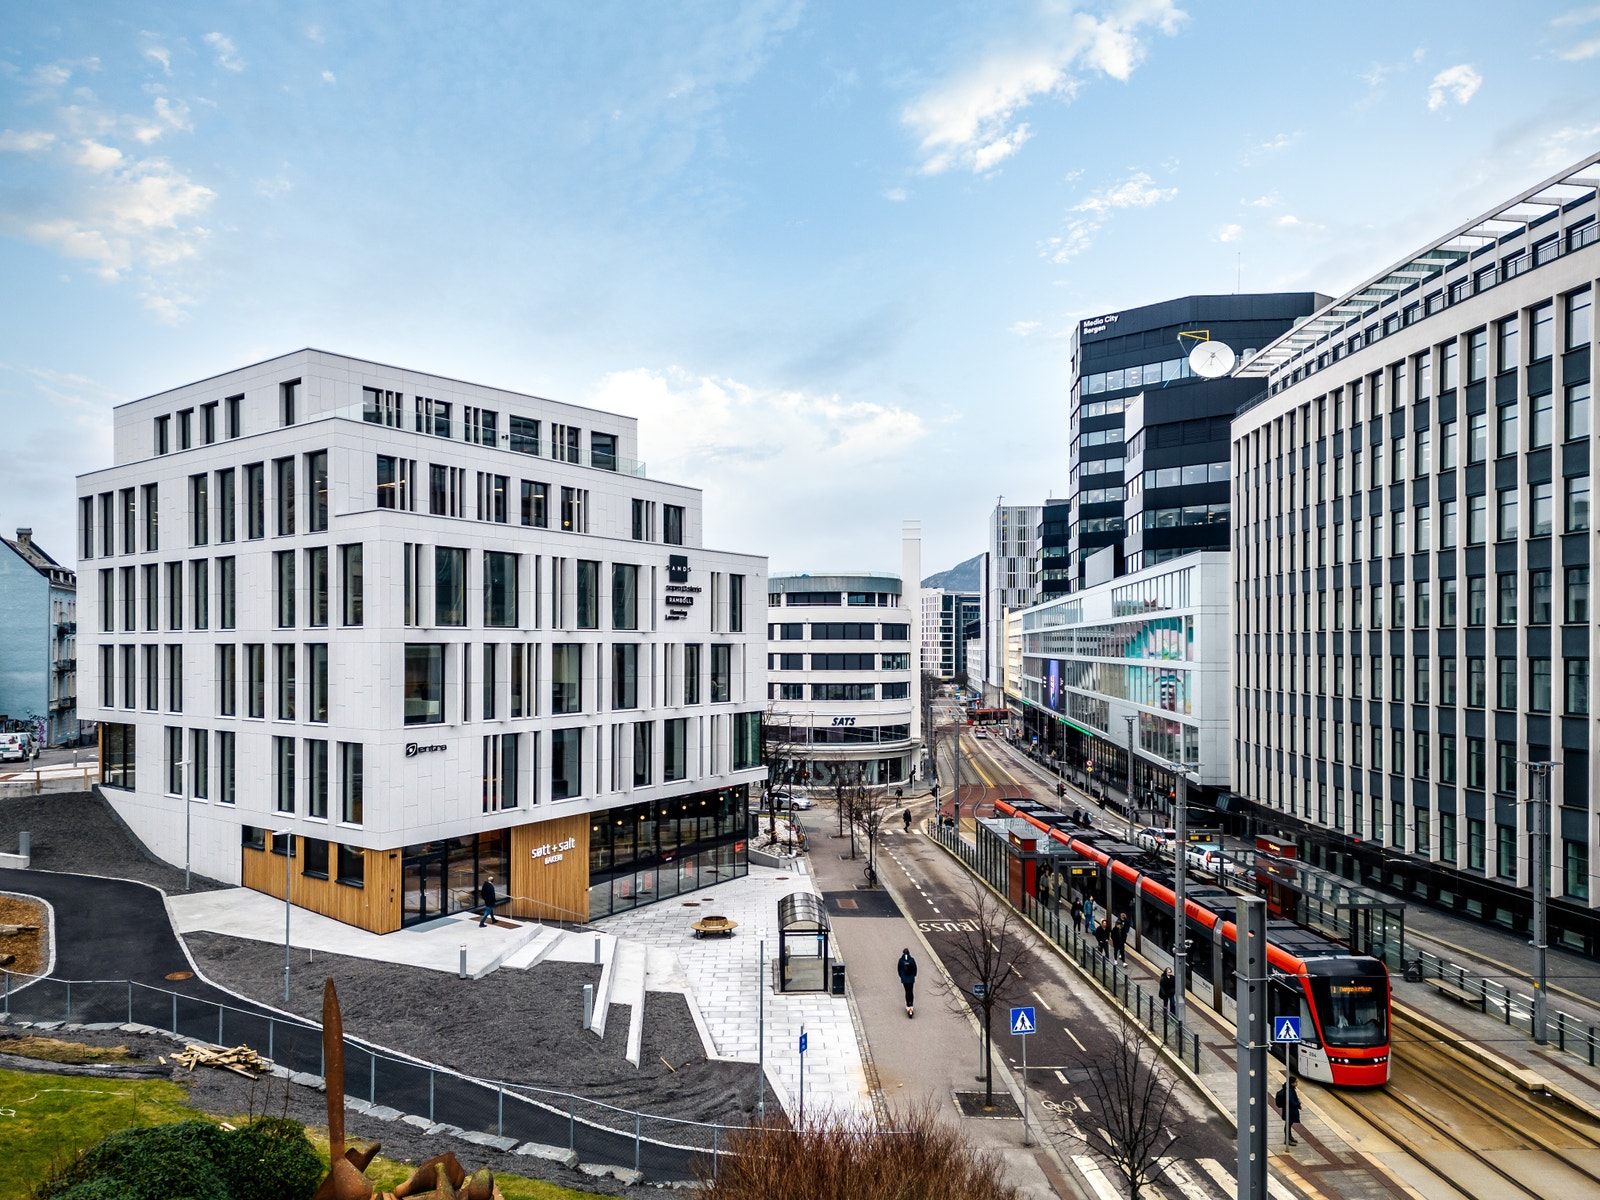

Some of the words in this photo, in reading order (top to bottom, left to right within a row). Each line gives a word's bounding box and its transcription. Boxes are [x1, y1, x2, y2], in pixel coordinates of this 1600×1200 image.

[1083, 317, 1104, 328] Media
[1104, 314, 1119, 323] City
[1083, 325, 1106, 335] Bergen
[831, 717, 856, 726] SATS
[418, 744, 447, 753] entra
[531, 844, 550, 858] søtt
[558, 837, 575, 851] salt
[545, 854, 563, 864] BAKERI
